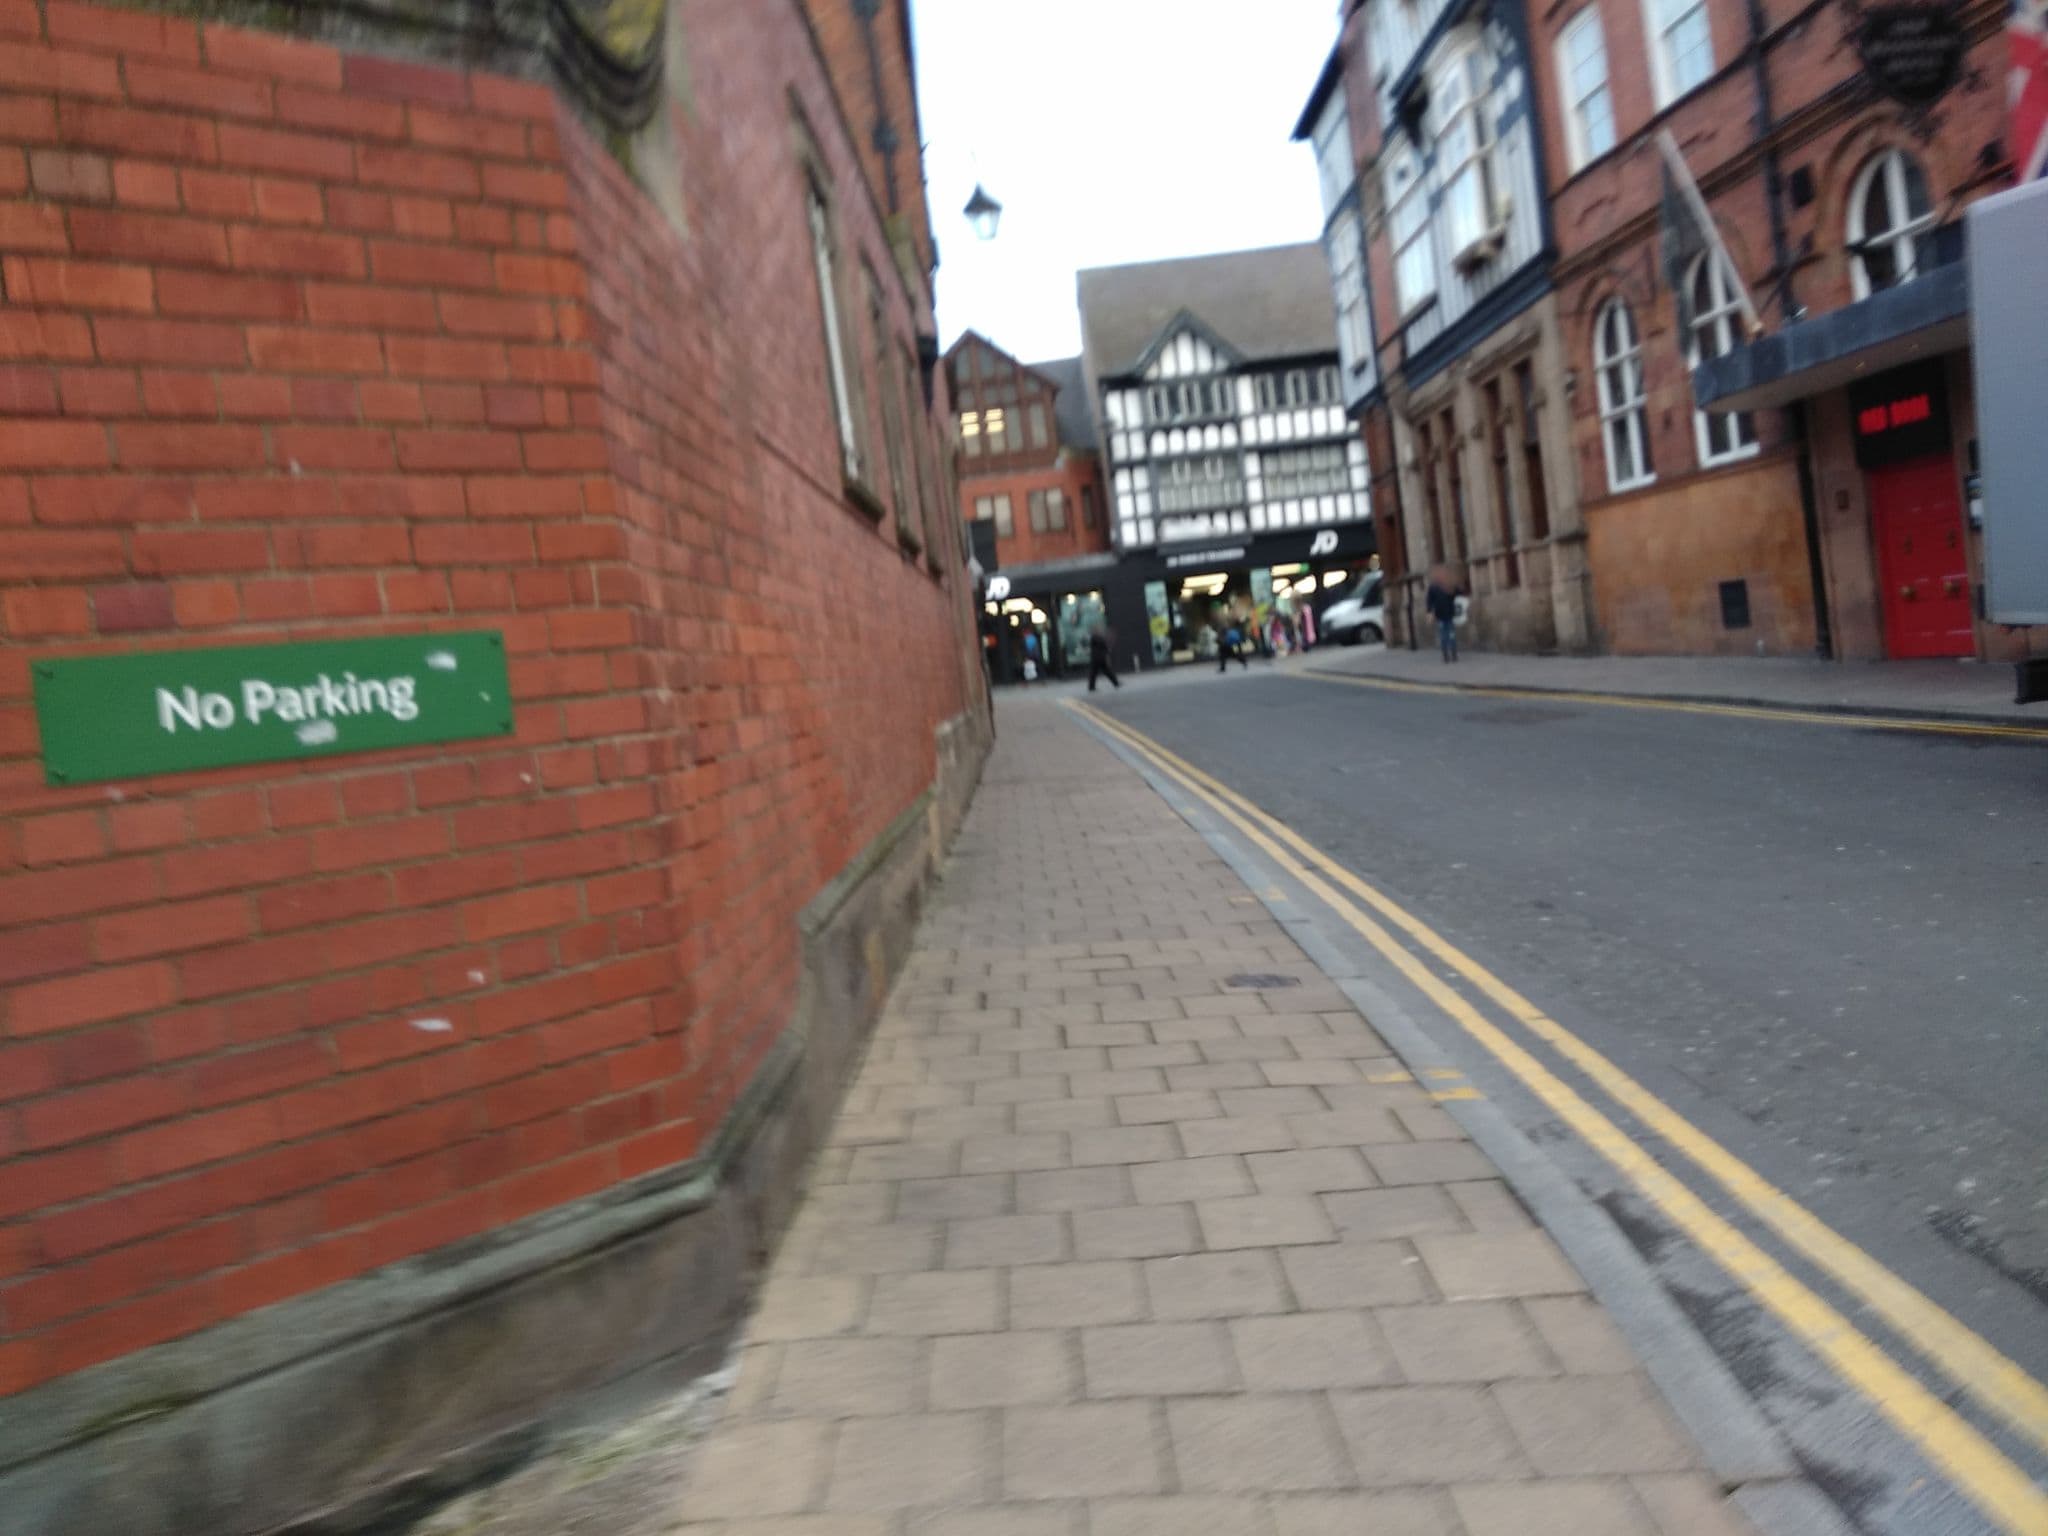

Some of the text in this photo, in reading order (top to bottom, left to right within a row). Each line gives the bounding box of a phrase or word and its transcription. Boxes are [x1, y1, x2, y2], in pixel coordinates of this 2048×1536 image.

[1310, 530, 1339, 556] JD
[985, 576, 1011, 600] JD
[156, 671, 419, 734] No Parking
